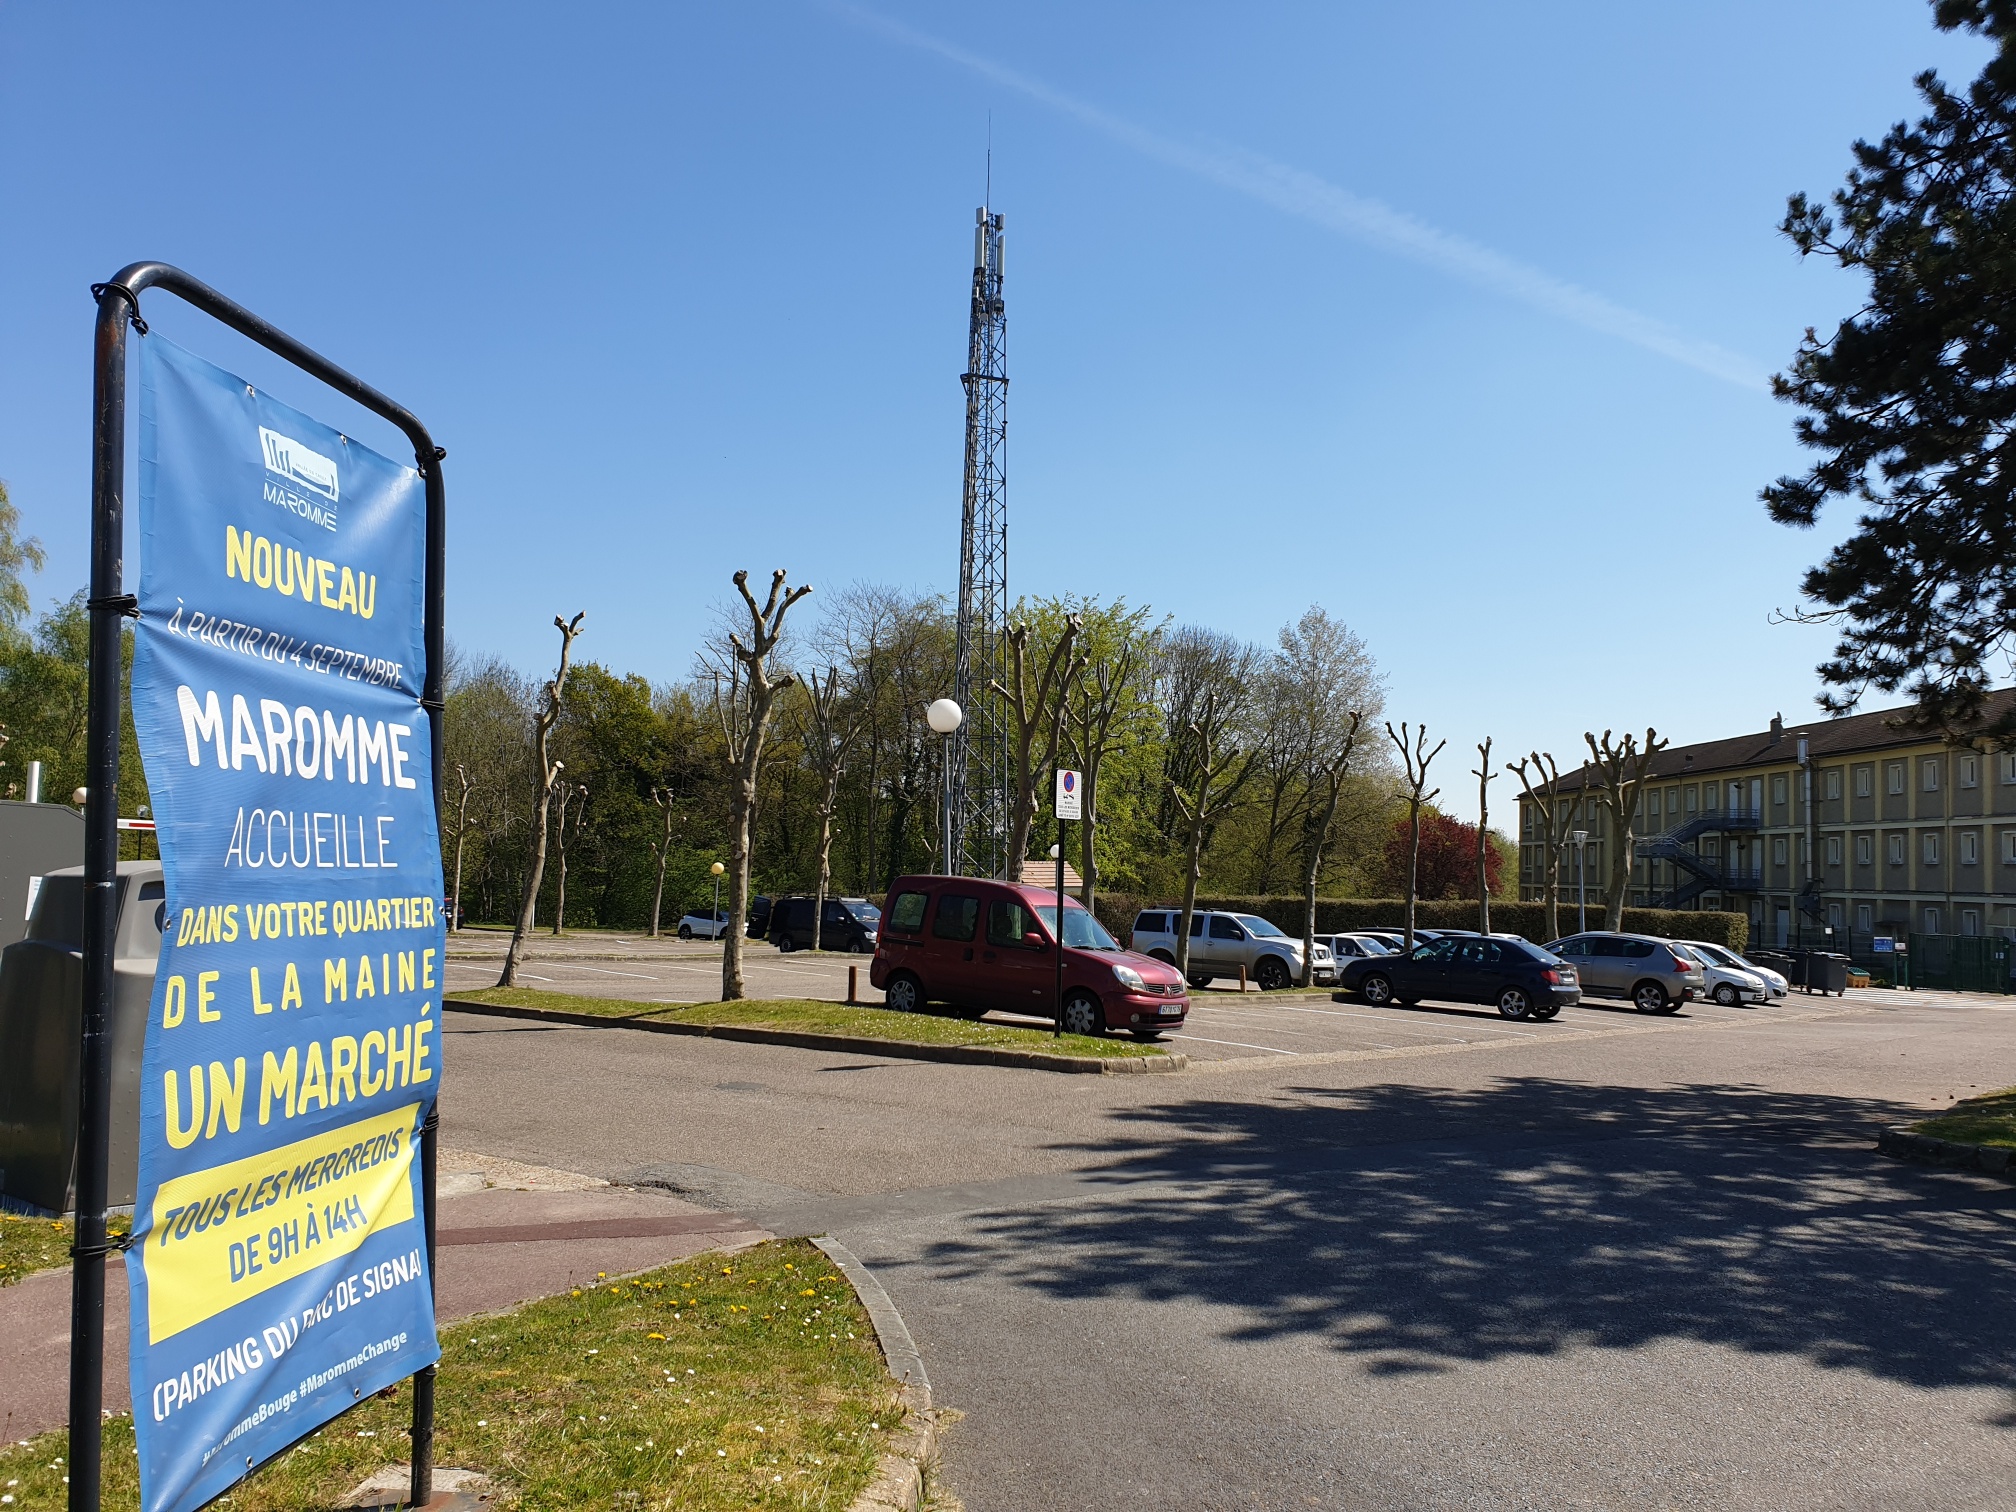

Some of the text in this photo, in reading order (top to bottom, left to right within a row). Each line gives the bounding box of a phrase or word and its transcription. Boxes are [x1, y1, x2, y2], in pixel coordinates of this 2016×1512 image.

[263, 482, 337, 532] MAROMME
[226, 525, 376, 619] NOUVEAU
[167, 596, 403, 690] À PARTIR DU 4 SEPTEMBRE
[177, 685, 416, 789] MAROMME
[224, 807, 398, 868] ACCUEILLE
[177, 897, 435, 948] DANS VOTRE QUARTIER
[163, 948, 436, 1028] DE LA MAINE
[164, 1001, 433, 1149] UN MARCHÉ
[160, 1127, 404, 1247] TOUS LES MERCREDIS
[228, 1194, 367, 1284] DE 9H À 14H
[153, 1336, 264, 1422] (PARKING
[263, 1316, 299, 1359] DU
[336, 1274, 361, 1312] DE
[299, 1331, 408, 1398] #MarommeChange
